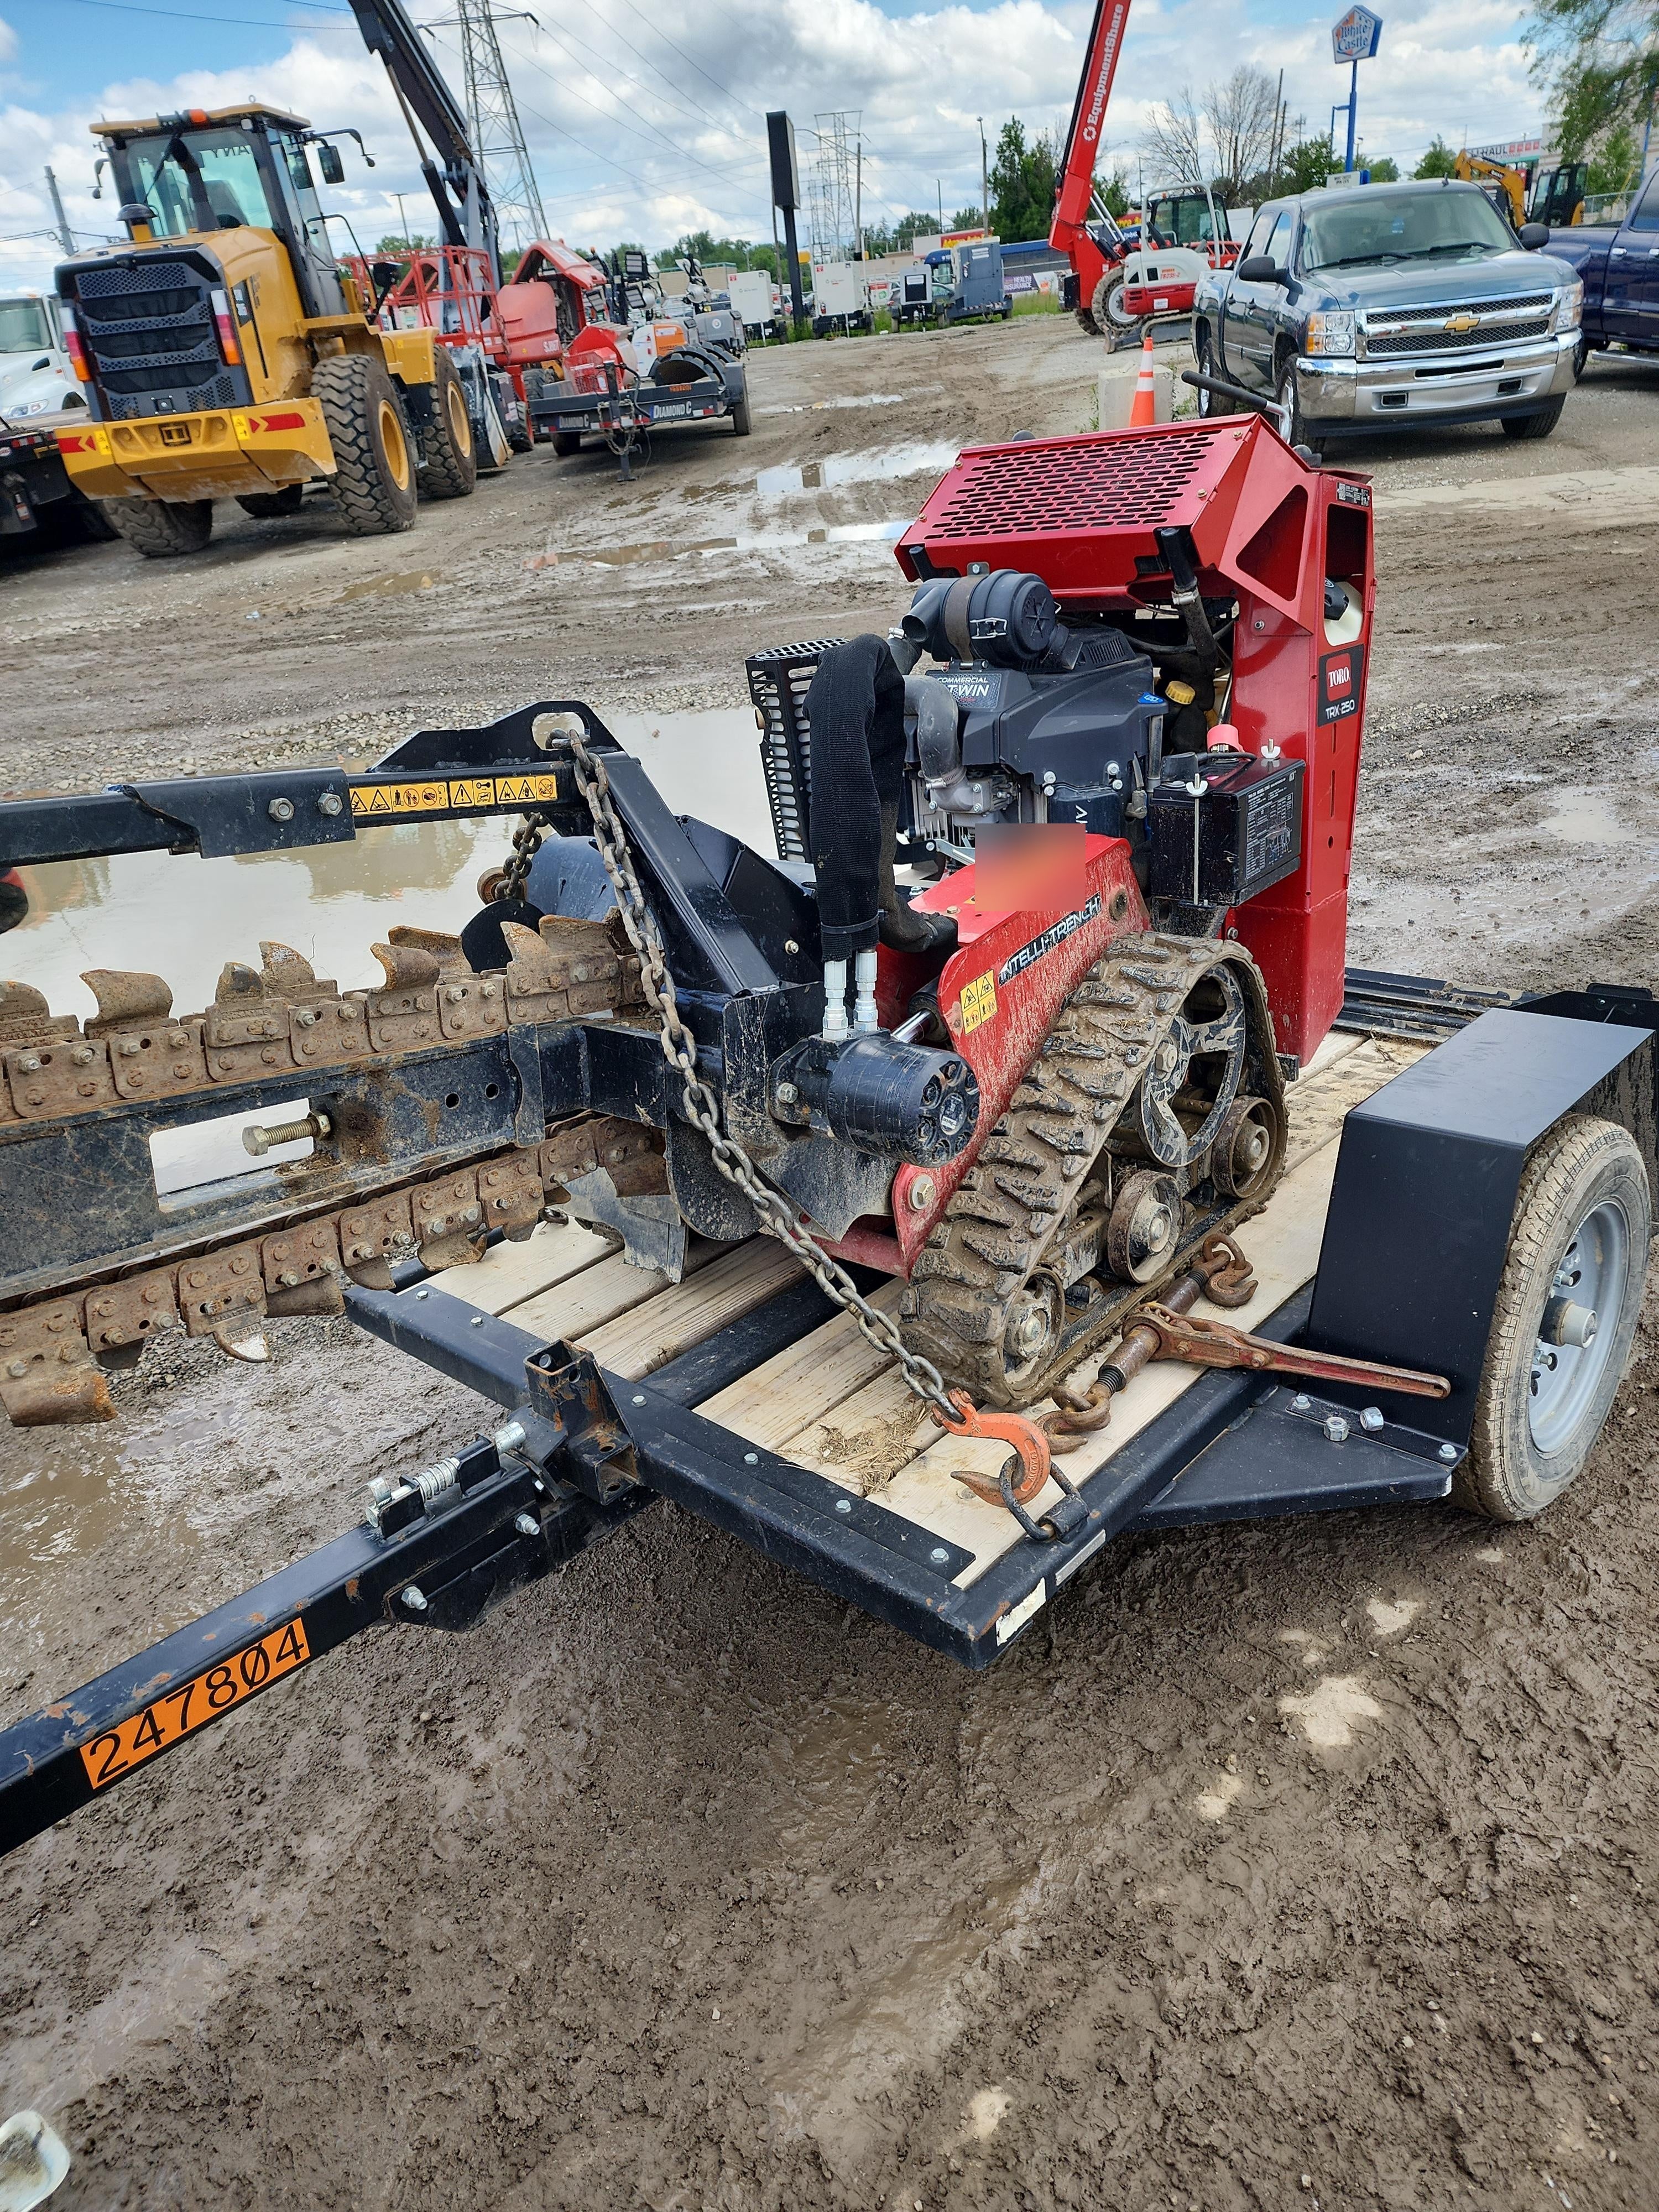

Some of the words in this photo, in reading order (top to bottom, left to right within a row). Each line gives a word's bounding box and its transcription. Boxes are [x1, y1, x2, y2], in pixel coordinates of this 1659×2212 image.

[1340, 24, 1368, 38] White
[1338, 35, 1369, 51] Castle
[1087, 3, 1124, 126] EquipmentShare
[654, 404, 685, 419] DIAMOND
[686, 401, 692, 414] C
[1328, 666, 1350, 687] TORO
[89, 1623, 305, 1784] 247804
